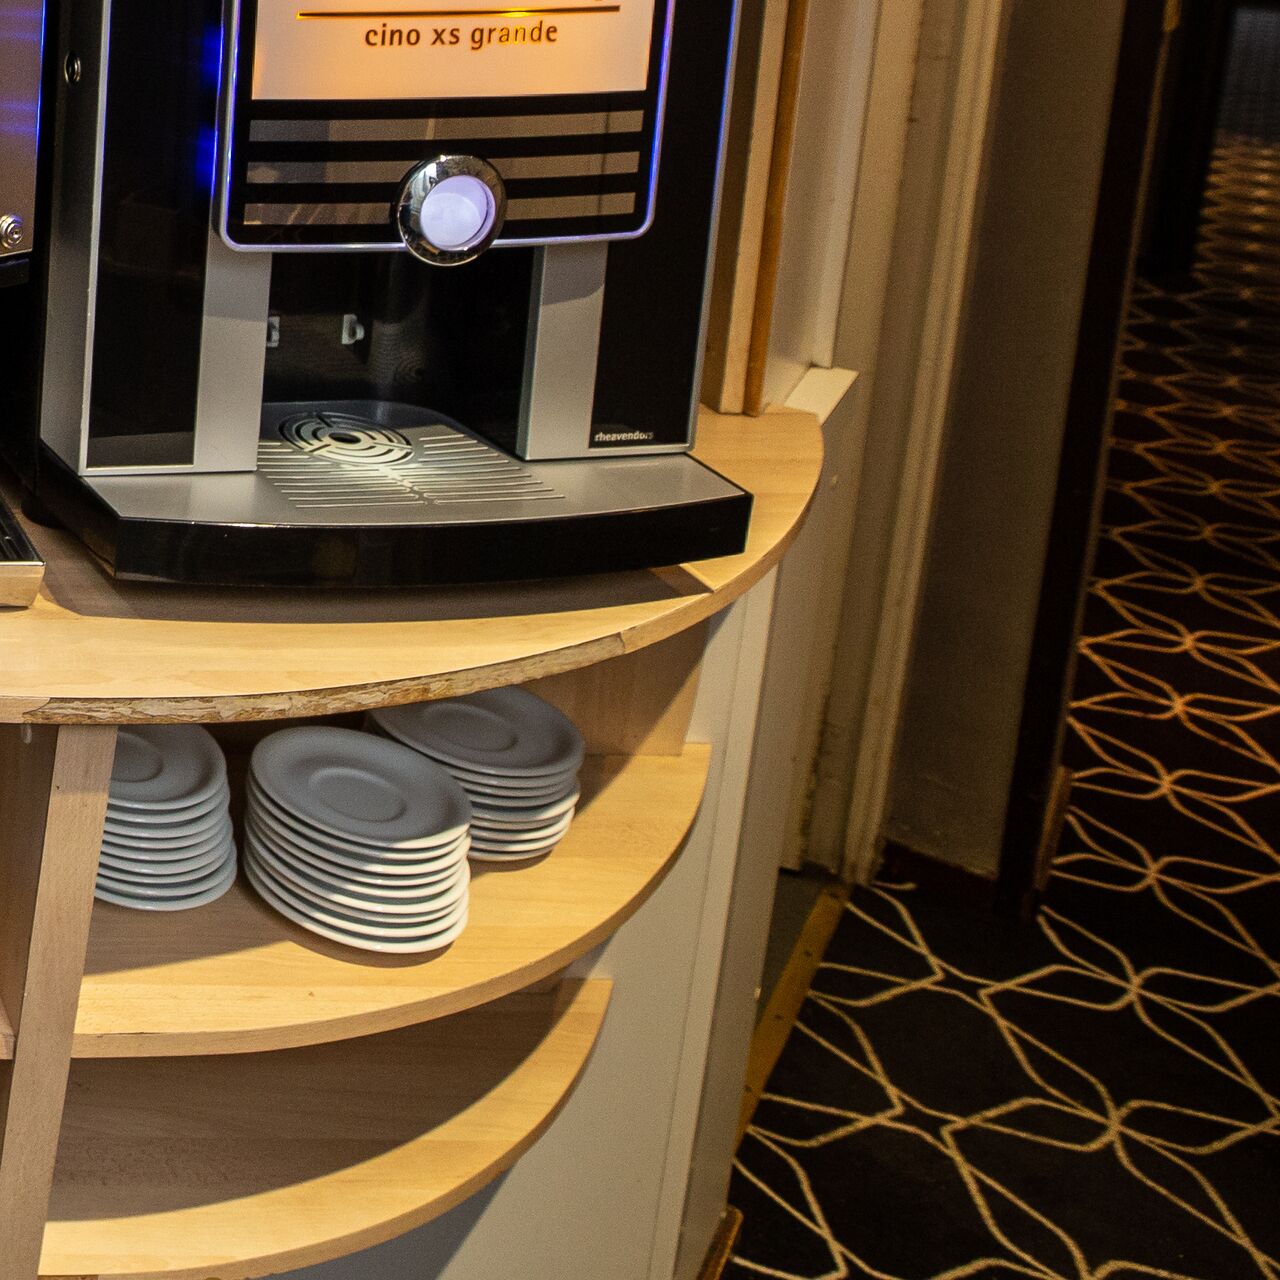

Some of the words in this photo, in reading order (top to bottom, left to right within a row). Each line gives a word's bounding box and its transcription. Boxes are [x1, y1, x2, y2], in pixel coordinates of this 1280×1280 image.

[365, 21, 421, 47] cino
[431, 25, 460, 45] xs
[471, 19, 558, 50] grande
[594, 430, 654, 442] rheavendors
